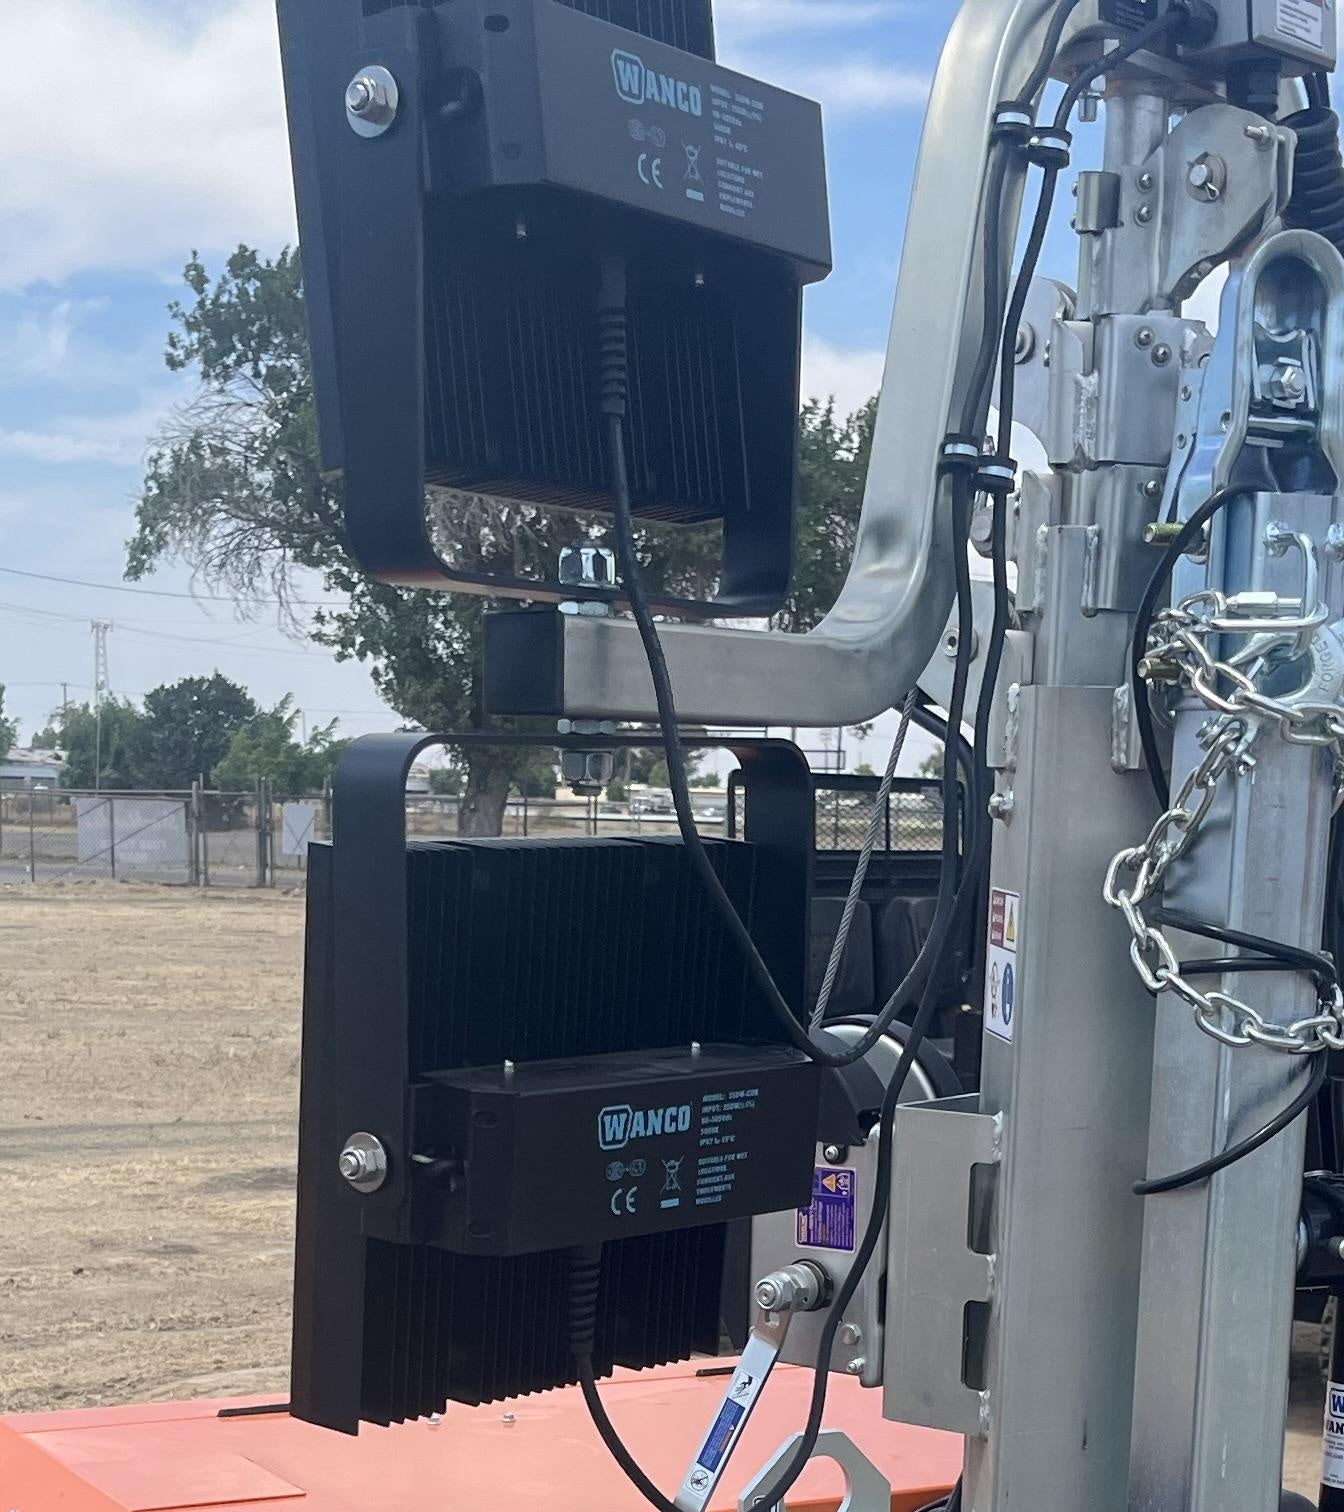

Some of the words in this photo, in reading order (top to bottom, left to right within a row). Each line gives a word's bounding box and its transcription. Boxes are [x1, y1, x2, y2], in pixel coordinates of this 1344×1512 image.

[612, 49, 702, 117] WANCO
[598, 1104, 691, 1150] WANCO
[611, 1186, 638, 1216] CE
